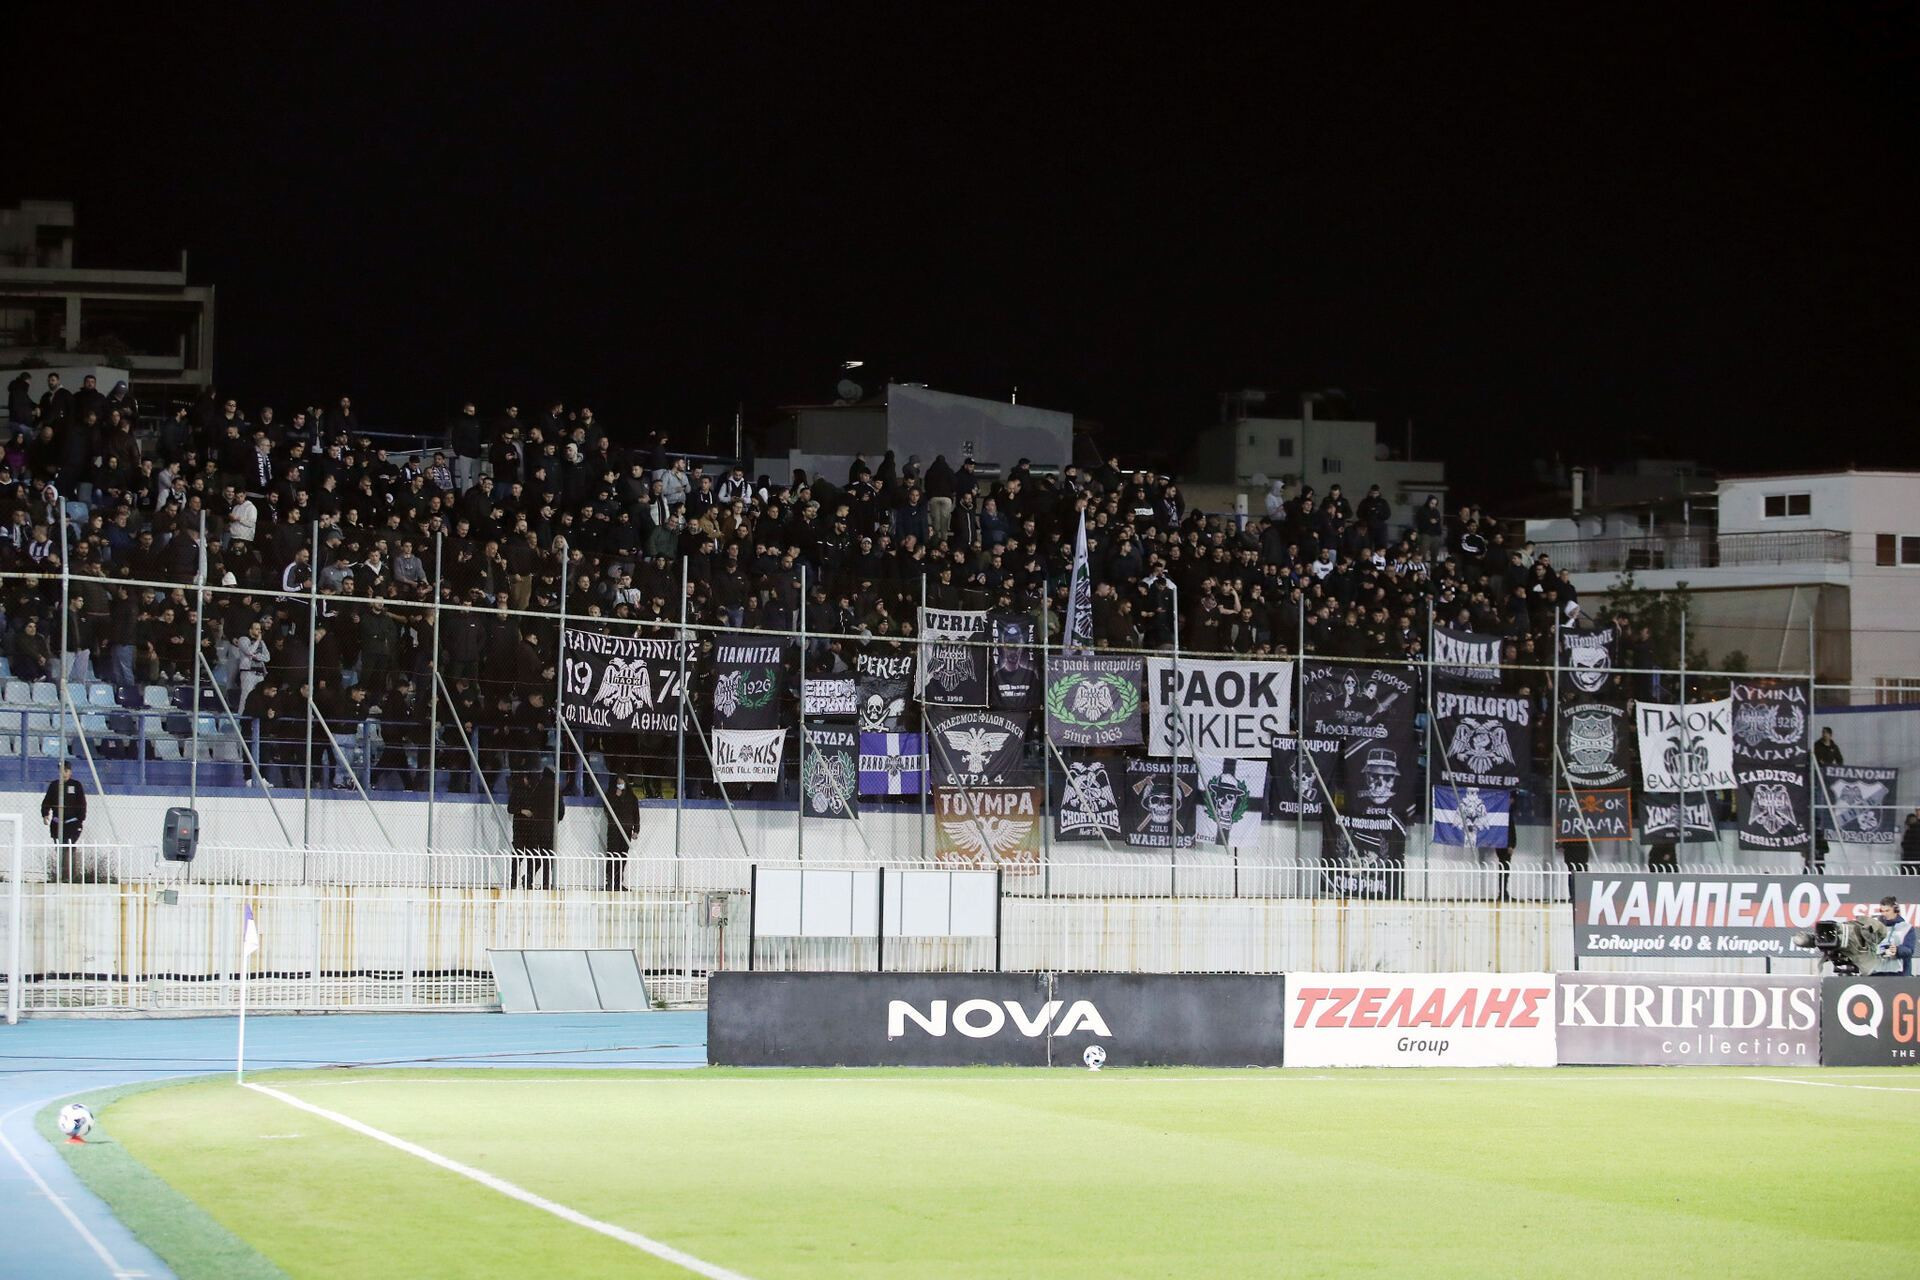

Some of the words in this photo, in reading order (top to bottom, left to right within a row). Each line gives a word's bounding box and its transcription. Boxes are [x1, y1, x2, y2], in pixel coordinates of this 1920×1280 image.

[925, 613, 985, 631] VERIA
[717, 646, 780, 664] ΓΙΑΝΝΙΤΣΑ
[857, 653, 912, 679] PEREA
[1063, 657, 1090, 673] paok
[1094, 657, 1141, 673] neapolis
[565, 657, 592, 696] 19
[657, 669, 691, 705] 74
[614, 677, 642, 686] ΠΑΟΚ
[1304, 666, 1333, 685] PAOK
[743, 678, 771, 696] 1926
[1160, 668, 1281, 708] PAOK
[1436, 691, 1530, 726] EPTALOFOS
[631, 712, 688, 732] ΑΘΗΝΩΝ
[979, 712, 1005, 728] ΦΙΛΩΝ
[1005, 720, 1025, 740] ΠΑΟΚ
[1163, 712, 1280, 750] SIKIES
[1642, 708, 1728, 737] ΠΑΟΚ
[805, 730, 856, 746] ΣΚΥΔΡΑ
[1063, 729, 1092, 744] since
[1095, 727, 1123, 744] 1963
[1273, 737, 1340, 753] CHRYOUPOLI
[1130, 760, 1197, 775] KASSANDRA
[1826, 766, 1896, 779] ΕΠΑΝΟΜΗ
[994, 774, 1005, 785] 4
[1441, 771, 1477, 783] NEVER
[1477, 774, 1503, 786] GIVE
[1503, 776, 1520, 787] UP
[1738, 768, 1803, 787] KARDITSA
[1150, 825, 1168, 833] ZULU
[1561, 818, 1627, 834] DRAMA
[1739, 830, 1781, 847] THESSALY
[1782, 832, 1808, 847] BLOCK
[1587, 880, 1851, 928] ΚΑΜΠΕΛΟΣ
[1587, 934, 1665, 952] Σολωμού
[1669, 935, 1692, 951] 40
[1696, 935, 1711, 951] &
[1717, 934, 1784, 954] Κύπρου,
[1293, 988, 1550, 1028] ΤΖΕΛΑΛΗΣ
[1558, 983, 1816, 1031] KIRIFIDIS
[888, 999, 1112, 1038] NOVA
[1892, 992, 1920, 1043] G
[1397, 1036, 1449, 1056] Group
[1662, 1033, 1806, 1056] collection
[1892, 1050, 1915, 1058] THE
